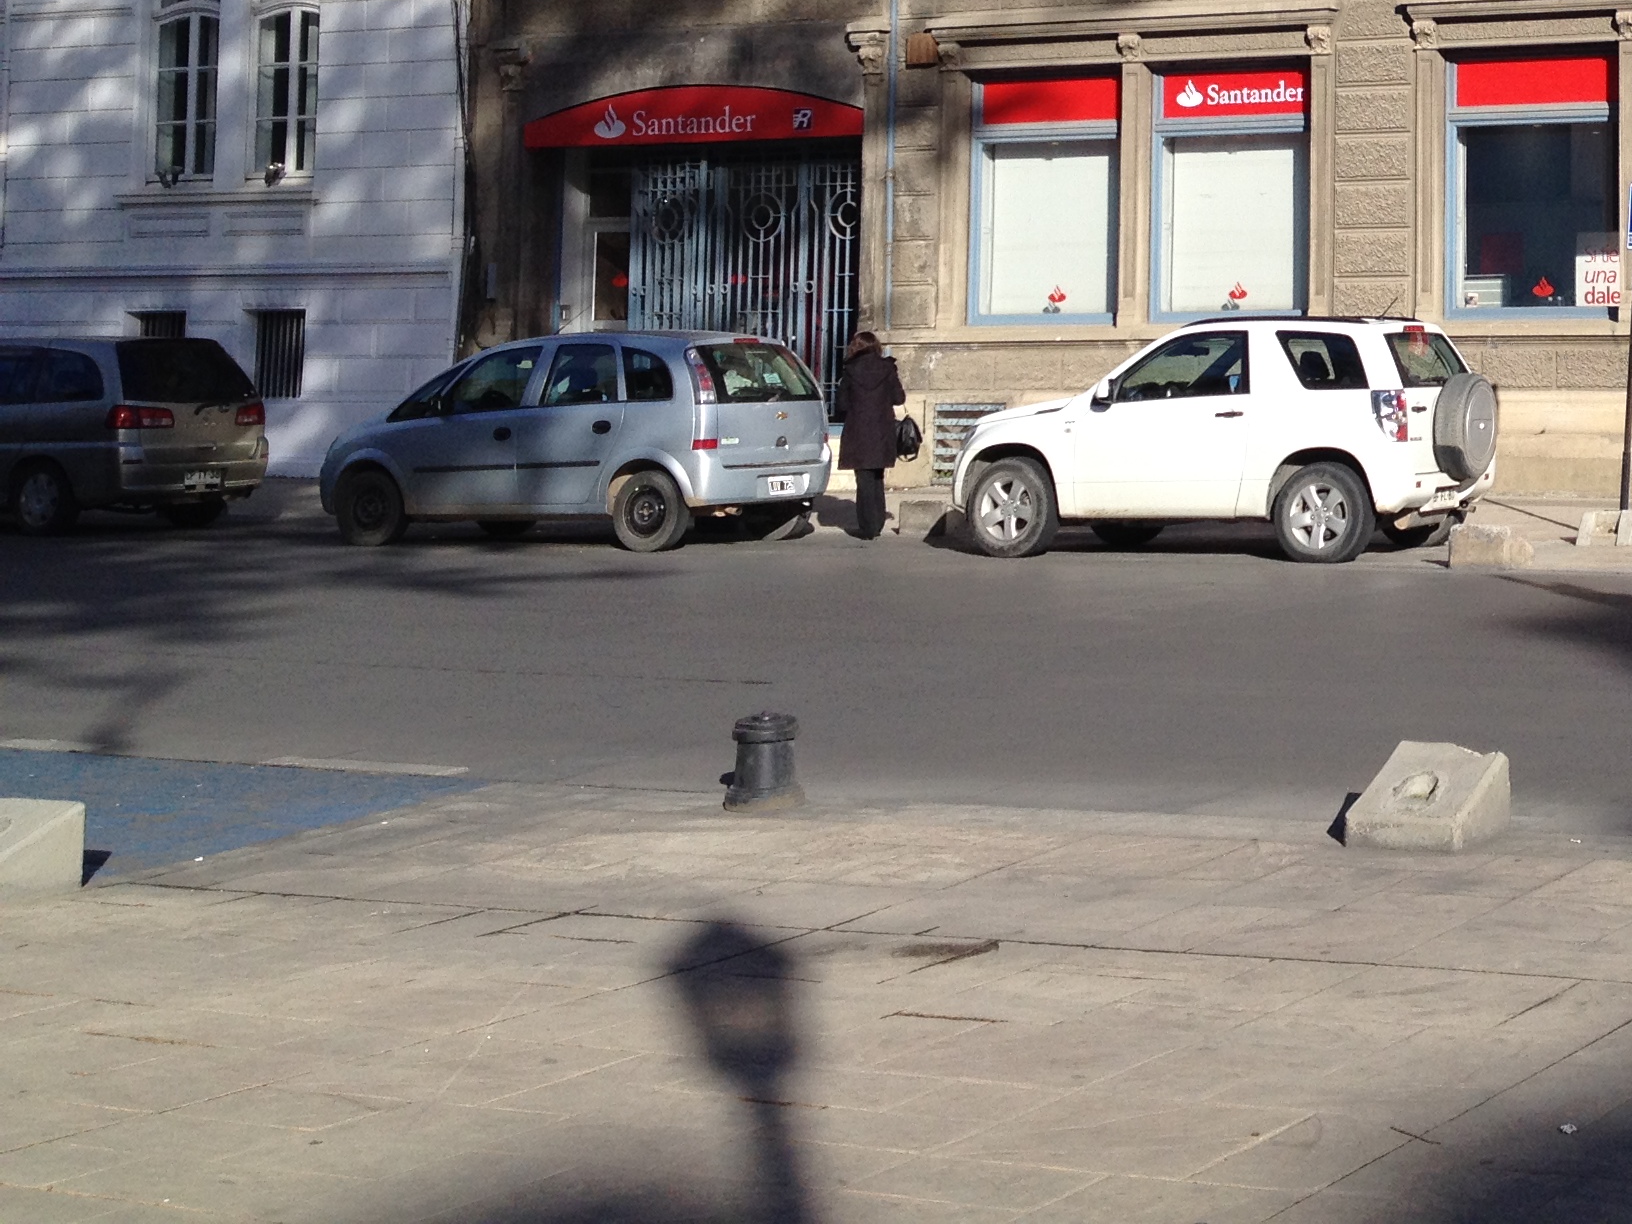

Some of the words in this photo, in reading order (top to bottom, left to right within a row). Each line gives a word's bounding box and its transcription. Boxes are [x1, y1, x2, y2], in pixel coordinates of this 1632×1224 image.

[1207, 80, 1304, 105] Santander
[632, 105, 756, 136] Santander
[1584, 270, 1617, 284] una
[1584, 286, 1620, 304] dale
